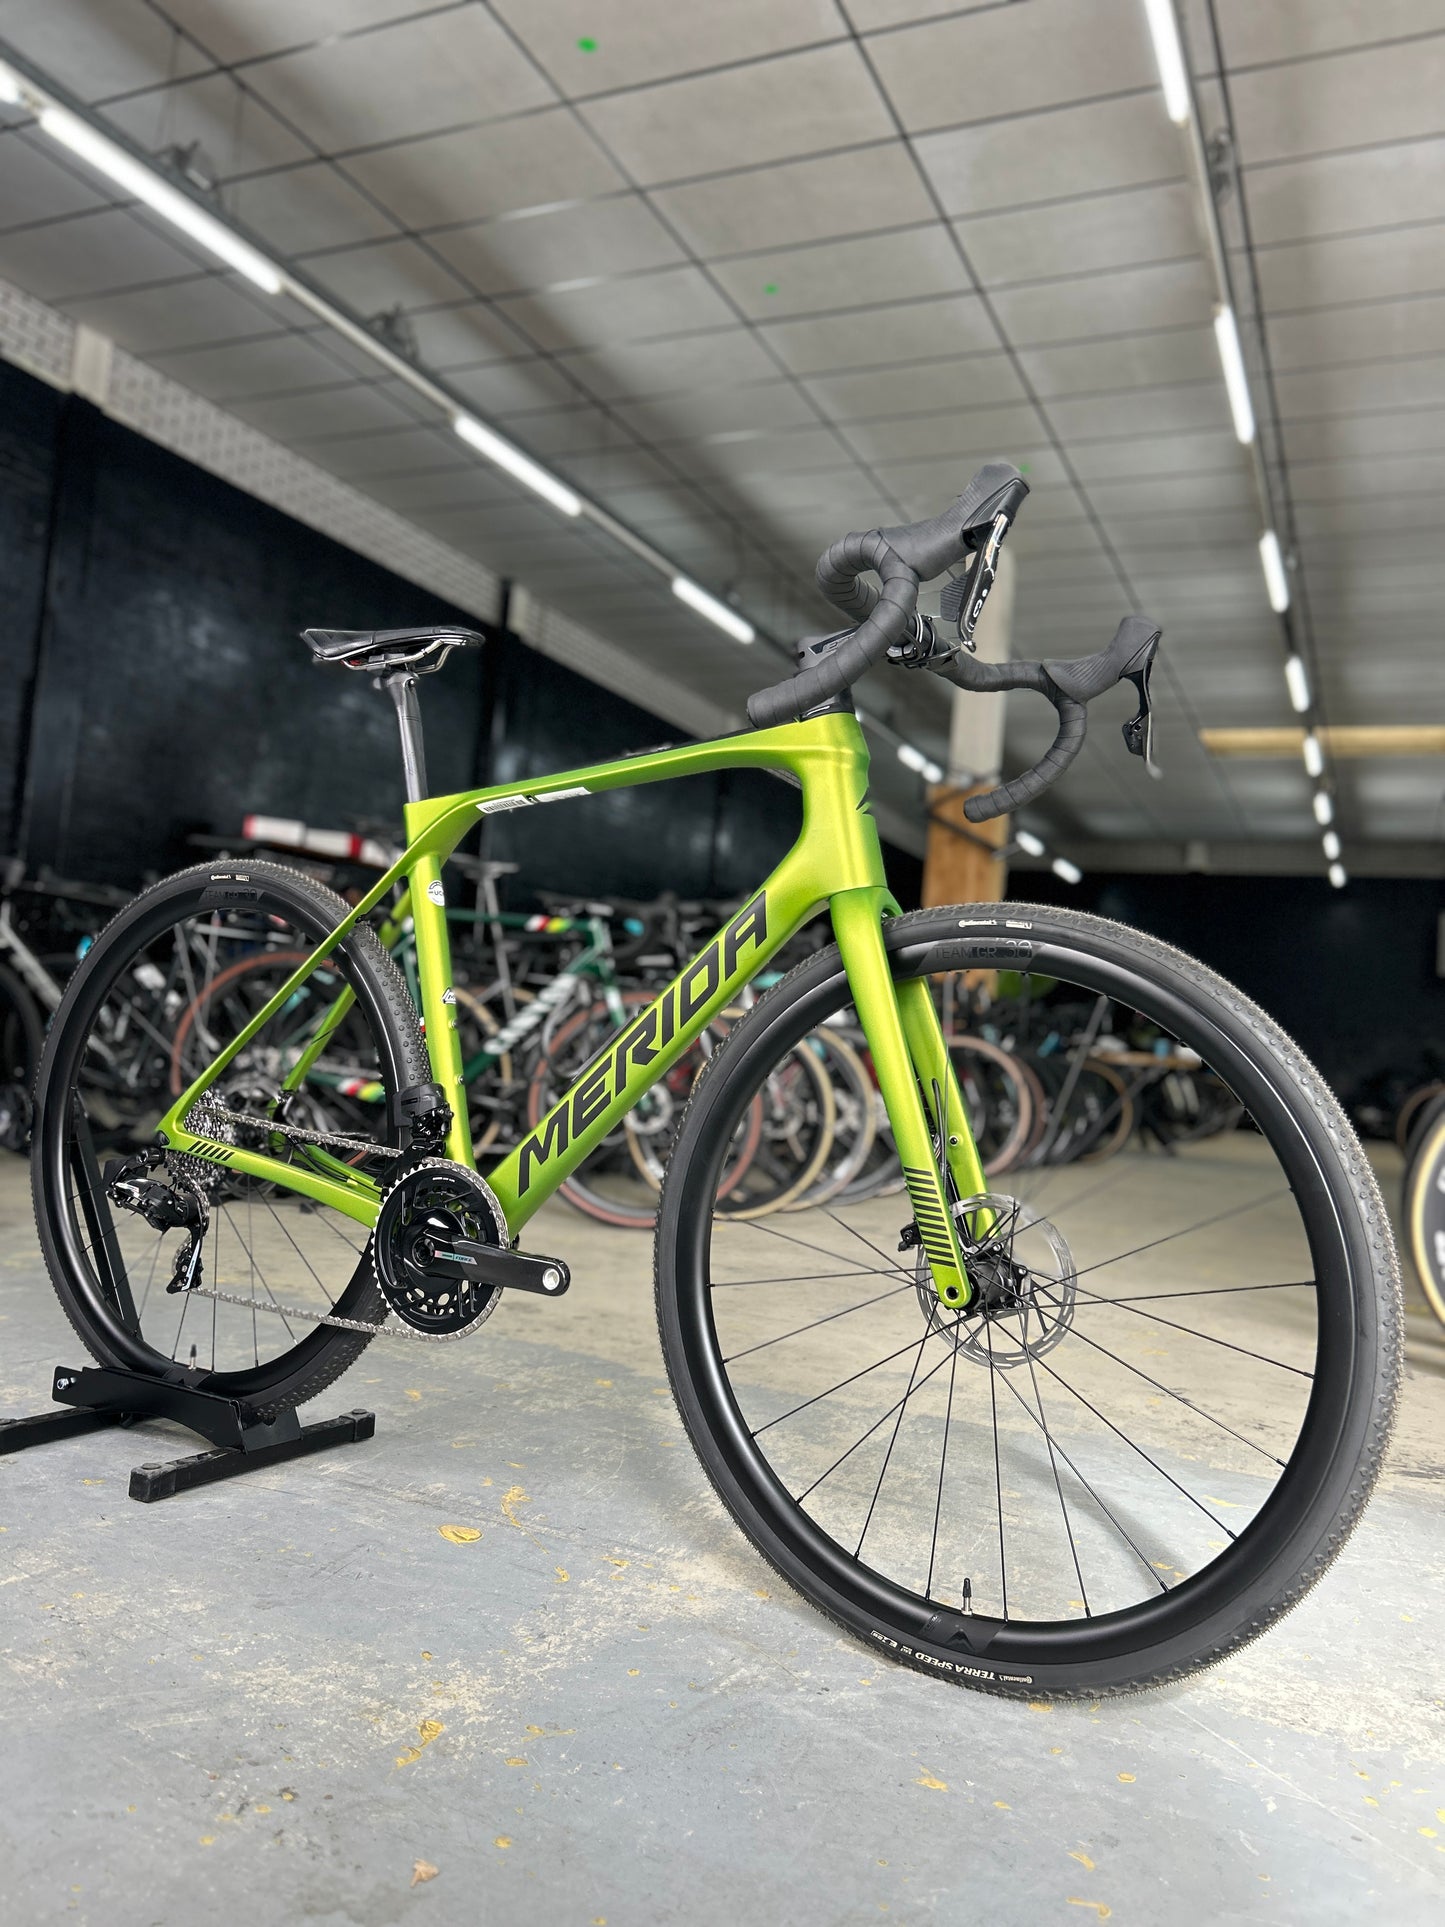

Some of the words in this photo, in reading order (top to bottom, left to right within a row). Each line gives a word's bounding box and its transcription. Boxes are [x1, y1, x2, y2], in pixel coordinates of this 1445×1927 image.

[934, 946, 972, 959] TEAM
[518, 889, 768, 1198] MERIDA
[914, 1651, 954, 1671] SPEED
[954, 1663, 995, 1680] TERRA
[1001, 1674, 1033, 1685] Continental
